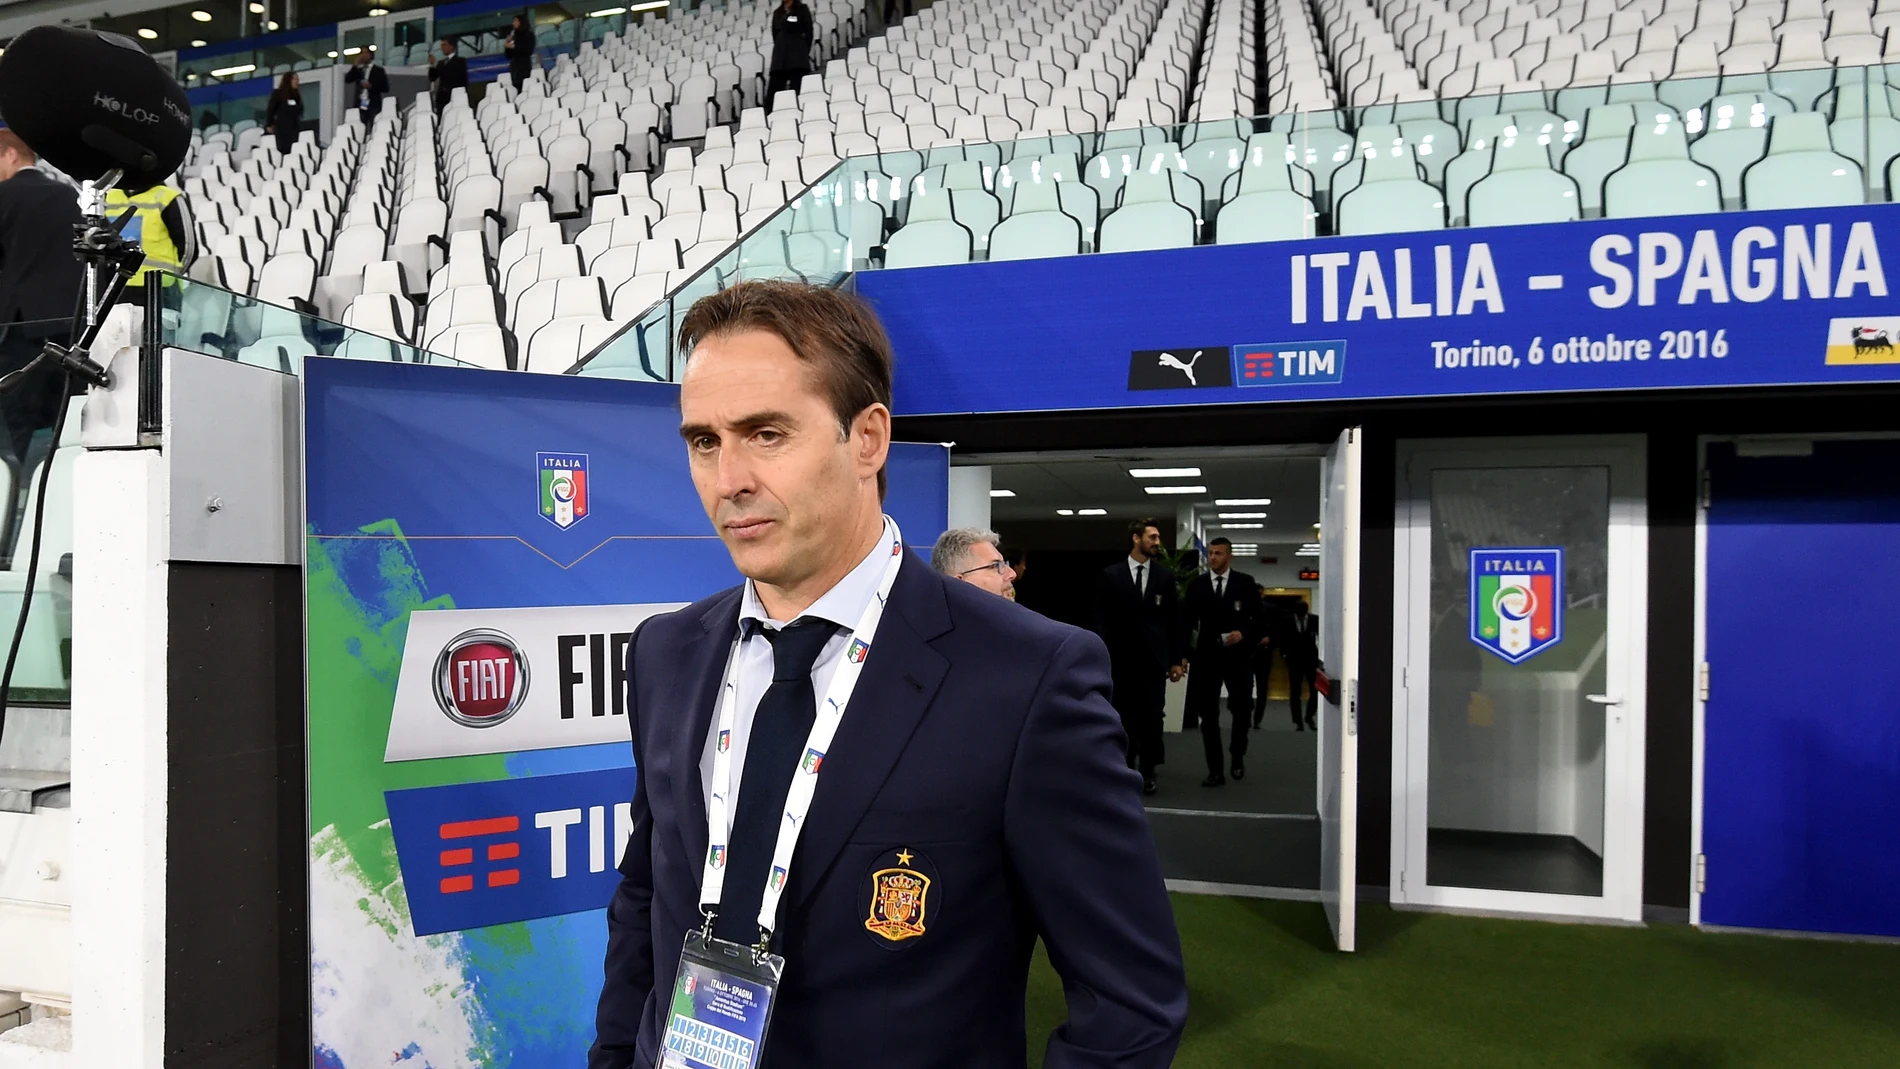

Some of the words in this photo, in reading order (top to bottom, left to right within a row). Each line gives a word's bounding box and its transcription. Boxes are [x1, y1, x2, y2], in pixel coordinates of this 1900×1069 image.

[1290, 242, 1505, 324] ITALIA
[1588, 222, 1888, 309] SPAGNA
[1278, 349, 1335, 376] TIM
[1430, 339, 1521, 369] Torino,
[1527, 336, 1545, 365] 6
[1551, 333, 1652, 364] ottobre
[1658, 329, 1729, 360] 2016
[543, 458, 581, 468] ITALIA
[1484, 559, 1545, 572] ITALIA
[457, 658, 510, 702] FIAT
[711, 978, 728, 992] ITALIA
[732, 985, 753, 1000] SPAGNA
[672, 1035, 680, 1049] 7
[683, 1040, 693, 1054] 8
[697, 1044, 705, 1058] 9
[708, 1048, 720, 1066] 10
[688, 1023, 697, 1037] 2
[700, 1027, 709, 1041] 3
[713, 1032, 722, 1046] 4
[727, 1037, 735, 1051] 5
[741, 1042, 749, 1056] 6
